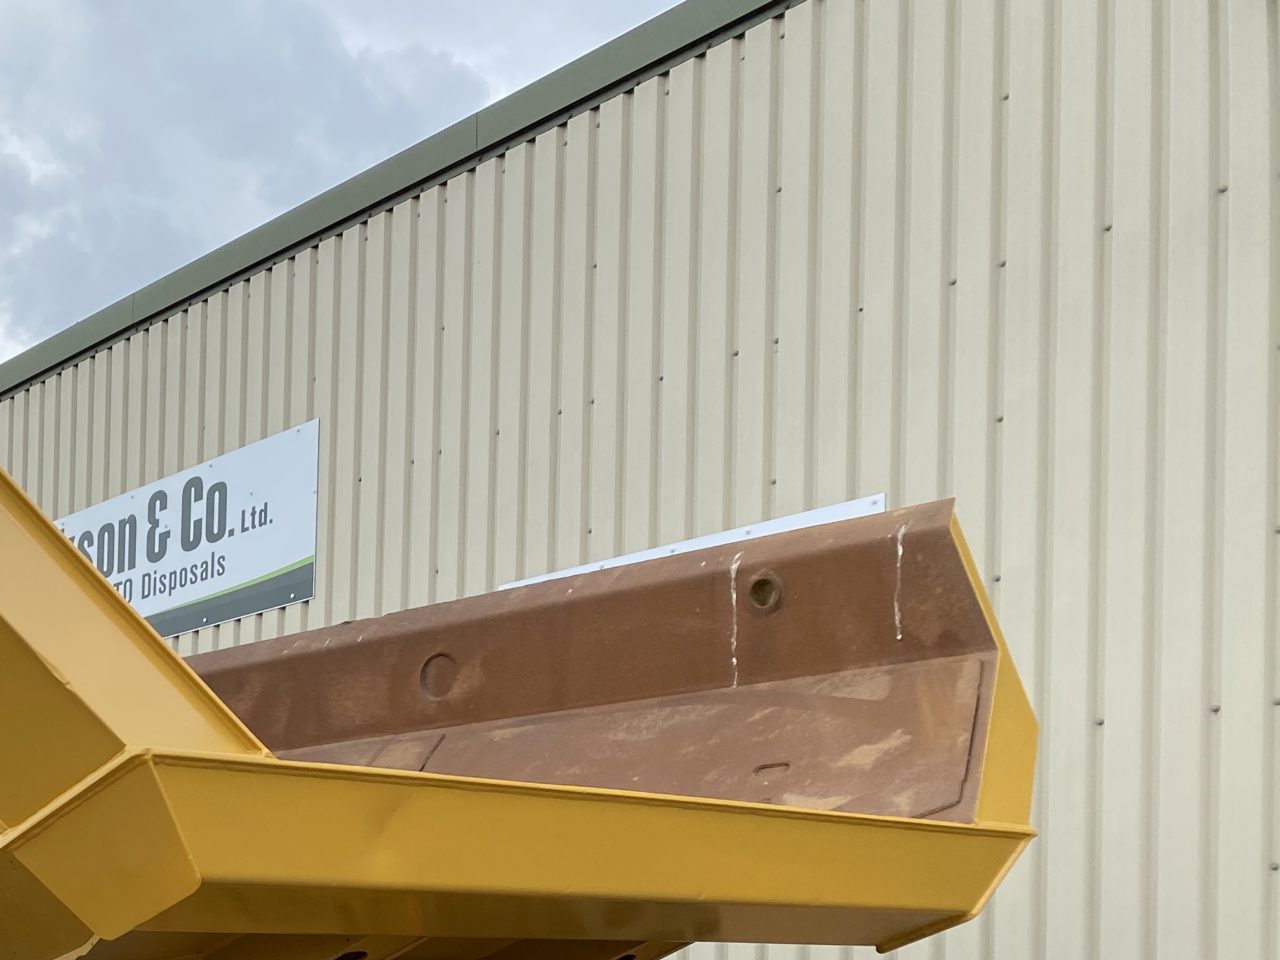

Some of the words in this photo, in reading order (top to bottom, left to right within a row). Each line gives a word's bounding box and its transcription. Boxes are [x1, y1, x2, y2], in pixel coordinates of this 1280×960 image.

[61, 514, 137, 578] son
[146, 490, 170, 563] &
[181, 476, 234, 552] Co.
[241, 502, 273, 533] Ltd.
[141, 552, 226, 599] Disposals
